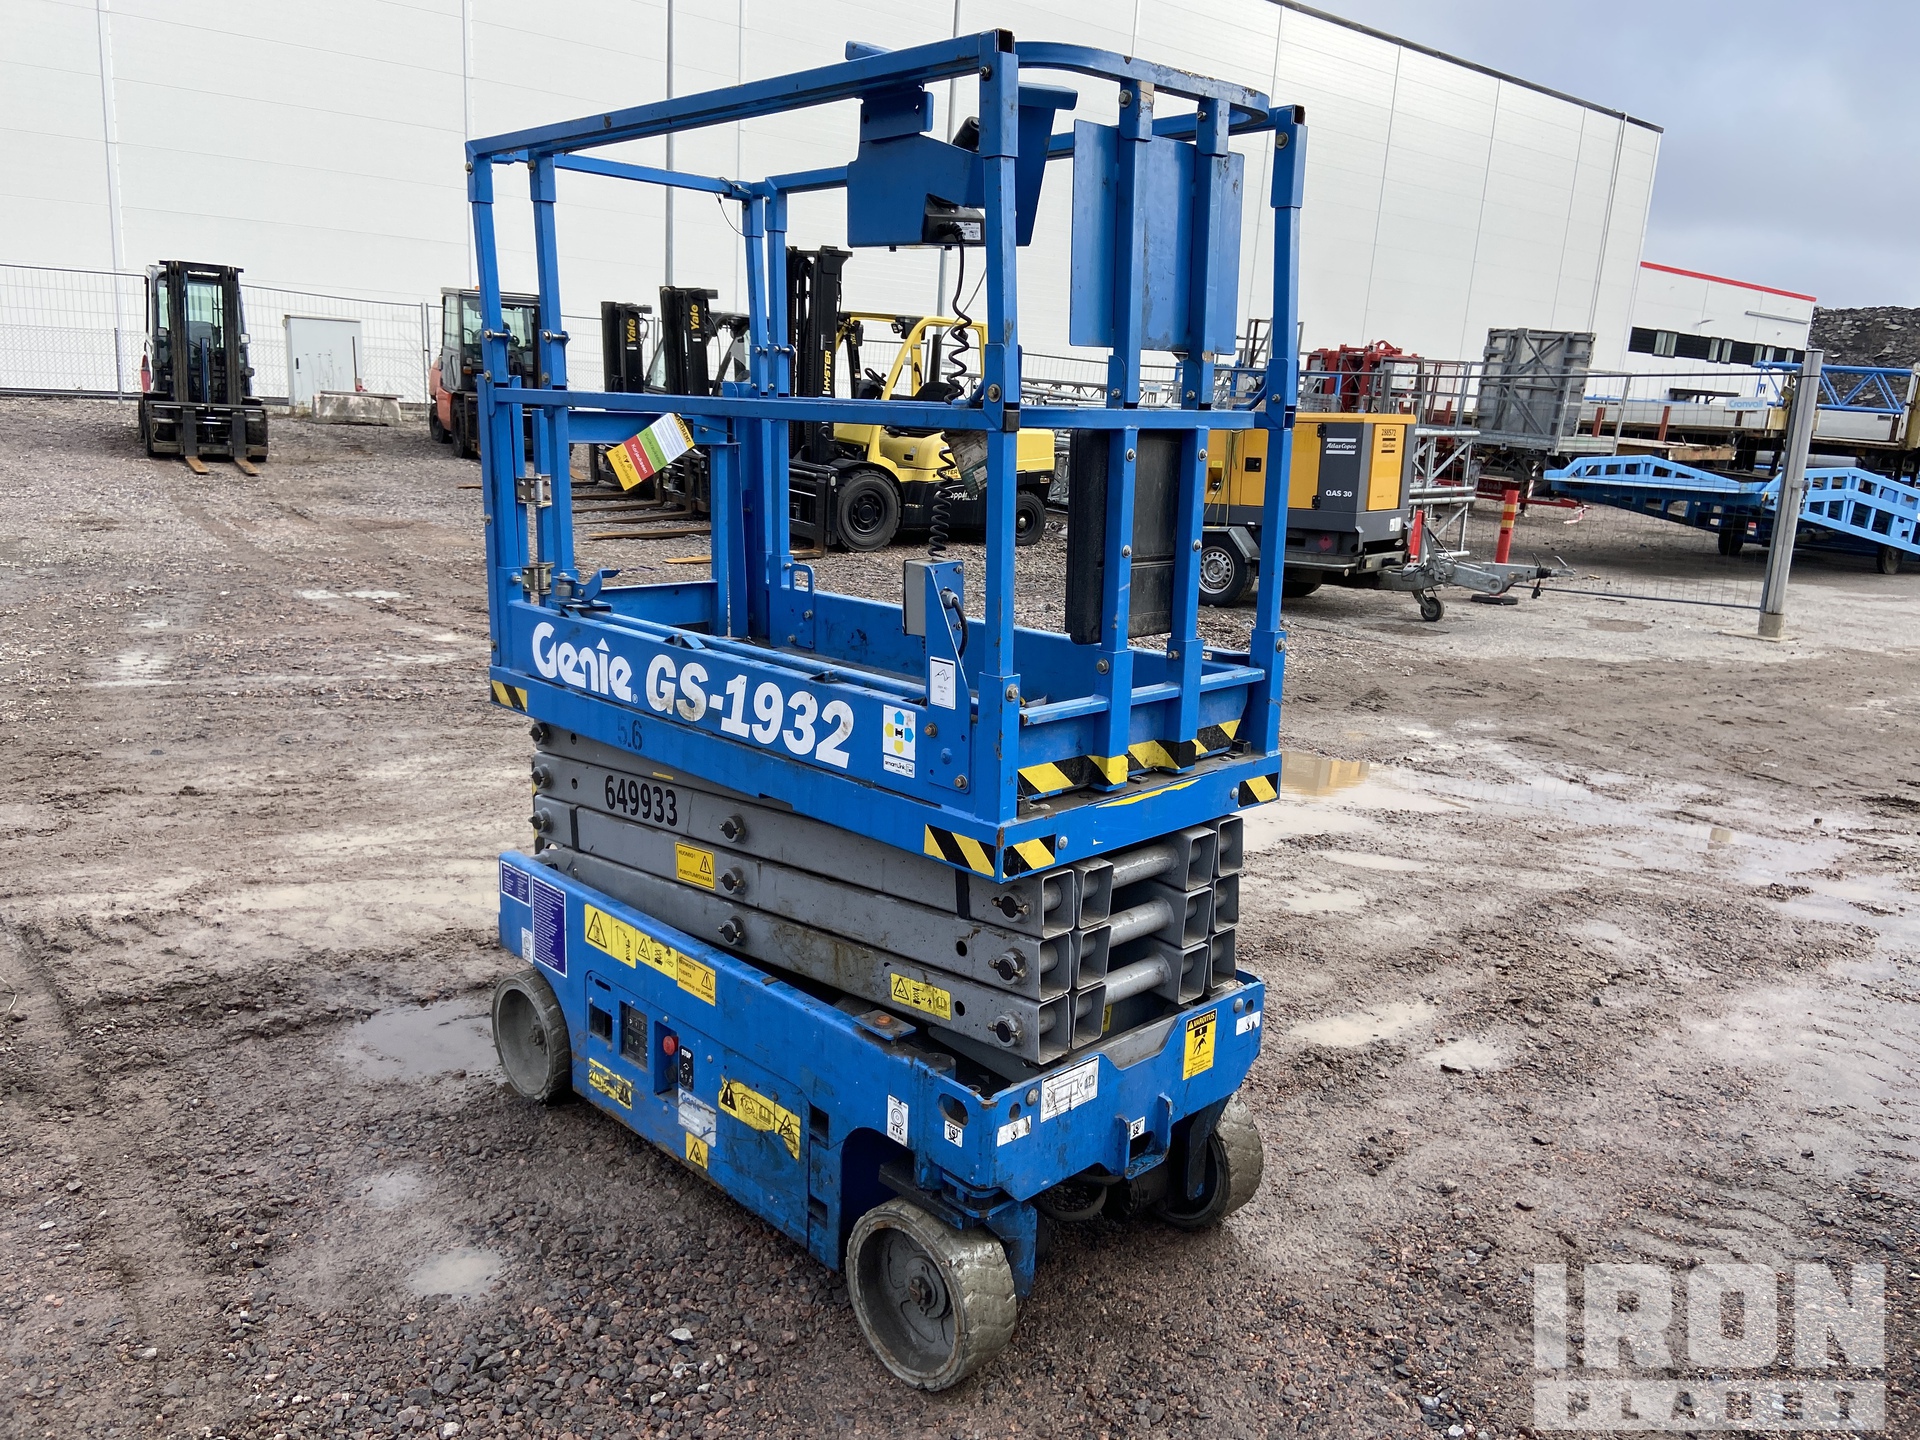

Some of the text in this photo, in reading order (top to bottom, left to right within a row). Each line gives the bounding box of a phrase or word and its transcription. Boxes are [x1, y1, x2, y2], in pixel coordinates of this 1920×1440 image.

[627, 318, 637, 343] Yale
[690, 304, 700, 331] Yale
[823, 350, 832, 391] HYSTER
[1325, 489, 1342, 497] QAS
[646, 653, 854, 770] GS-1932
[604, 774, 678, 827] 649933
